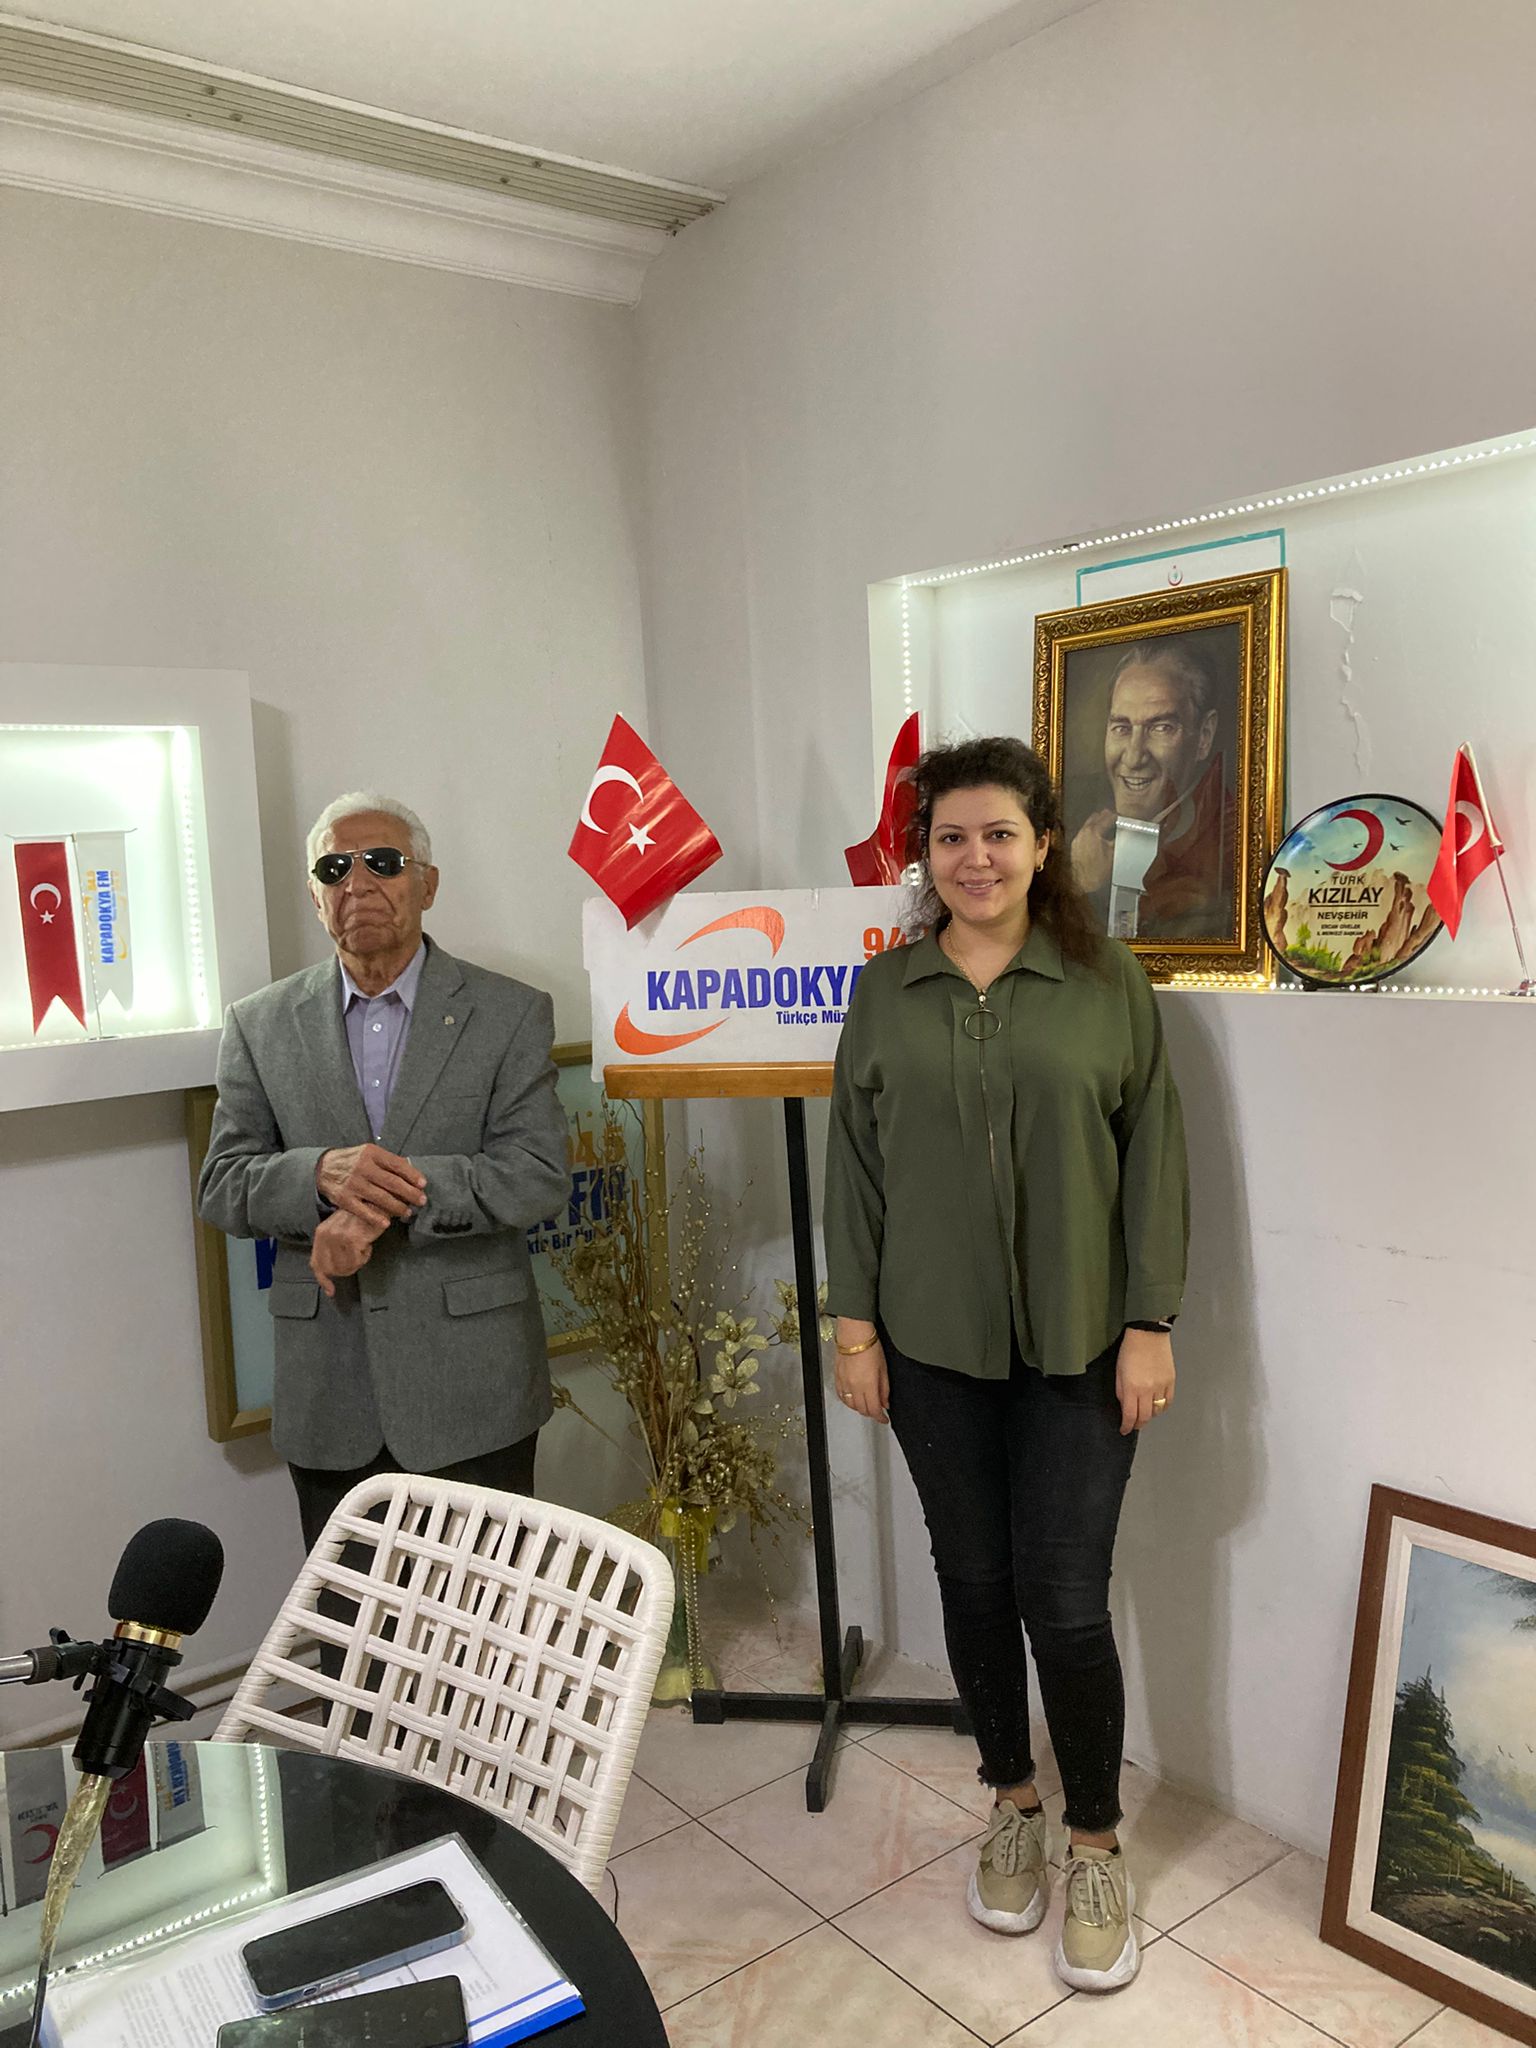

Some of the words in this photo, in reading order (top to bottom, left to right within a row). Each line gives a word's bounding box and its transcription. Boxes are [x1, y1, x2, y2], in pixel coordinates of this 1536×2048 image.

[96, 870, 110, 888] FM
[1332, 874, 1365, 886] TÜRK
[1308, 886, 1384, 904] KIZILAY
[1317, 911, 1368, 921] NEVŞEHİR
[97, 890, 115, 963] KAPADOKYA
[776, 1010, 818, 1026] Türkçe
[552, 1231, 572, 1249] Bir
